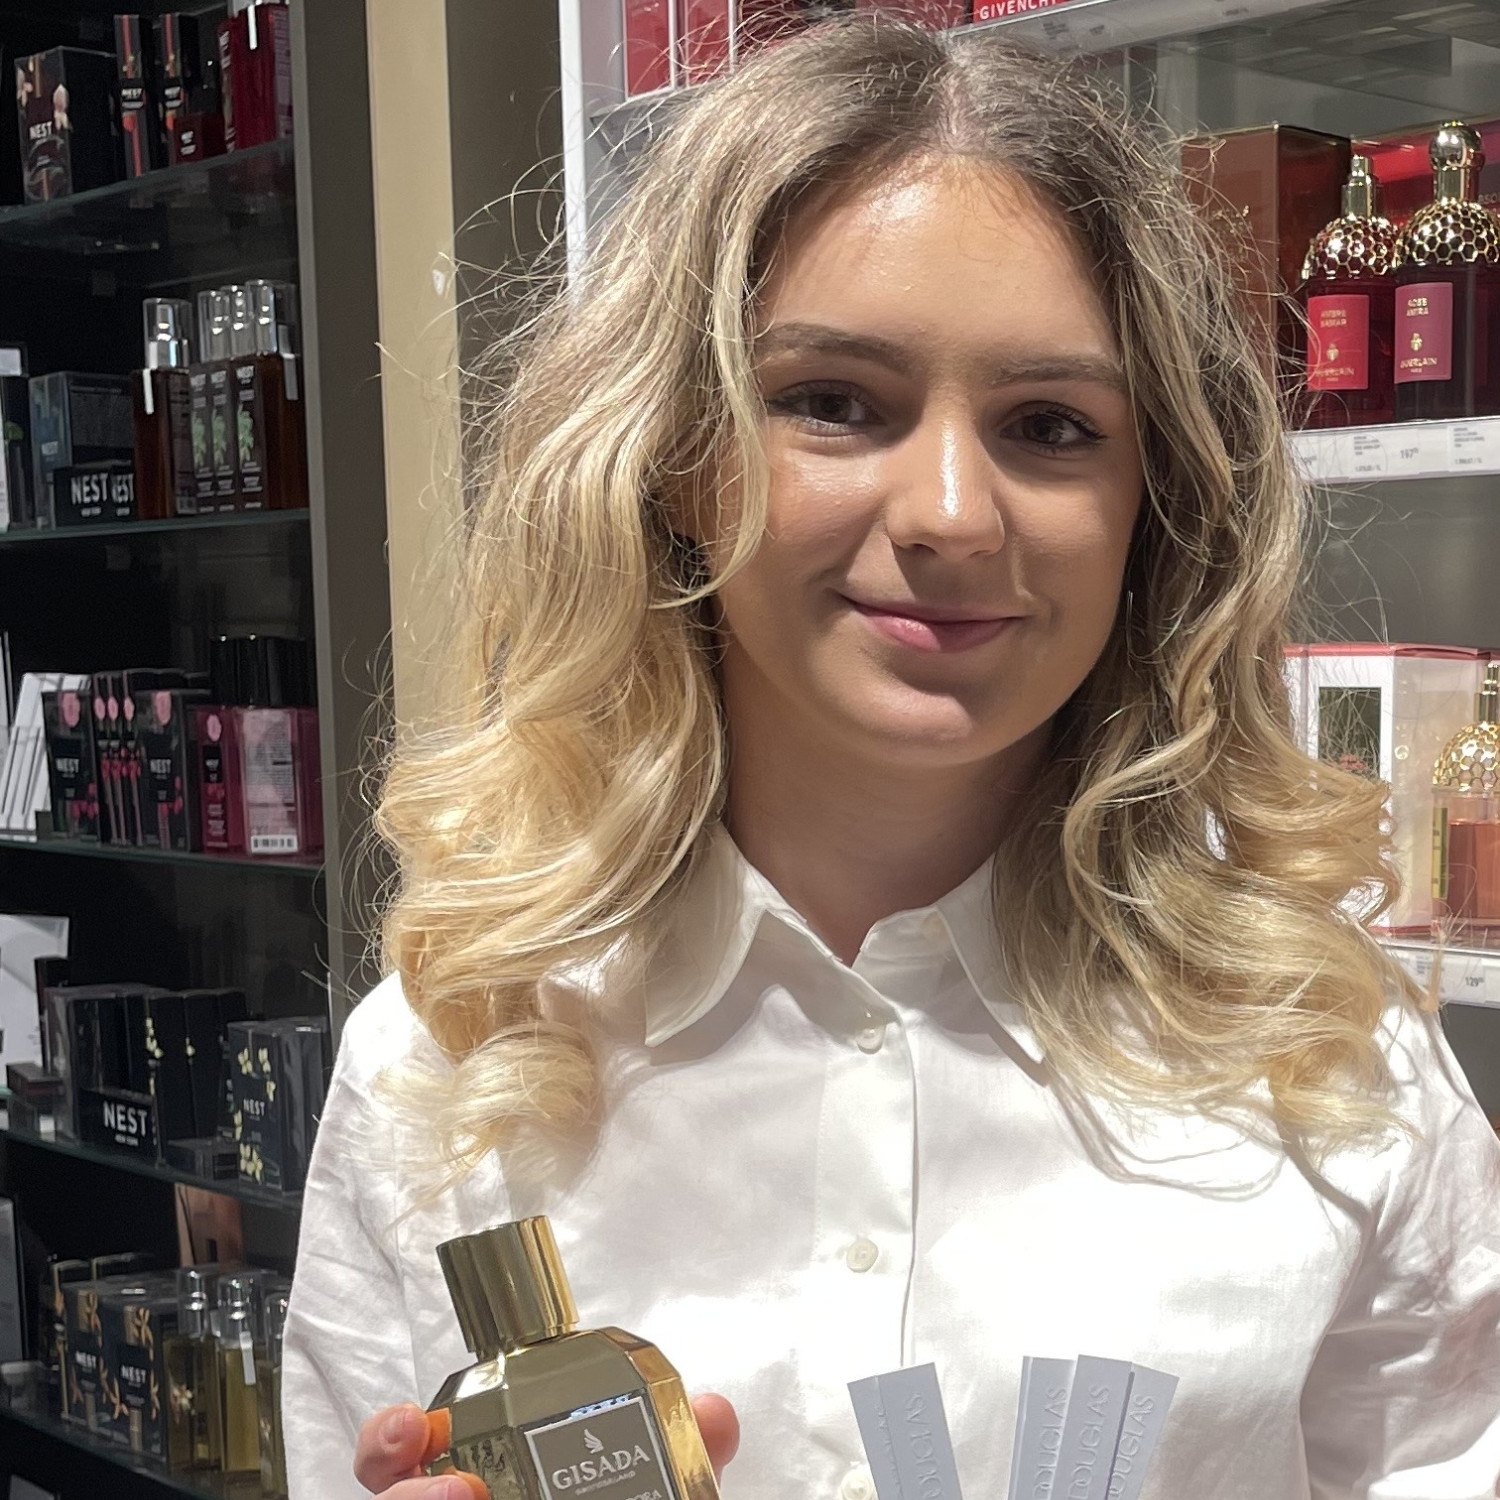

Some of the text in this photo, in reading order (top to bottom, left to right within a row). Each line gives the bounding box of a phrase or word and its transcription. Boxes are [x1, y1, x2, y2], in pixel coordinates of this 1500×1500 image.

[30, 121, 53, 140] NEST
[71, 472, 108, 505] NEST
[103, 1101, 148, 1137] NEST
[243, 1099, 265, 1115] NEST
[120, 1364, 146, 1384] NEST
[552, 1445, 650, 1489] GISADA
